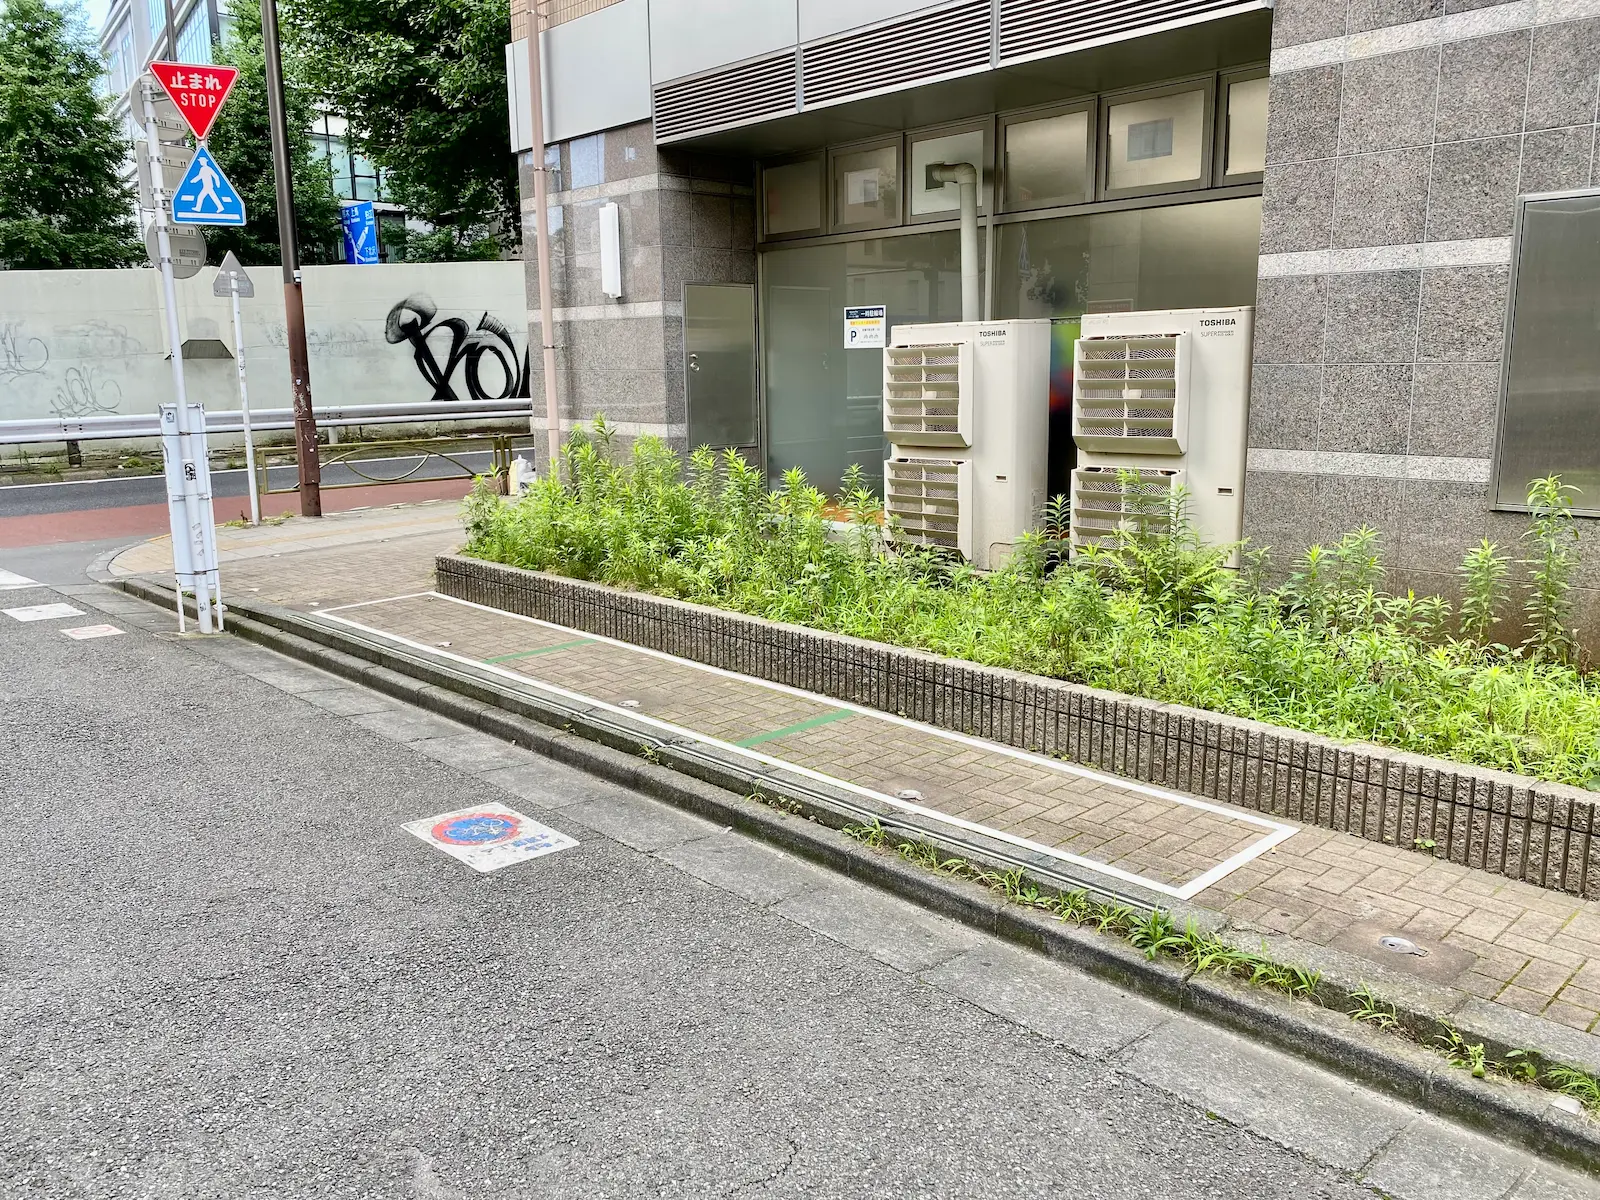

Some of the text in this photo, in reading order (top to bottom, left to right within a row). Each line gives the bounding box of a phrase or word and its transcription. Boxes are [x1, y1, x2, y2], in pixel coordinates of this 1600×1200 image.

[170, 71, 222, 90] 止まれ
[180, 93, 216, 107] STOP
[1199, 318, 1236, 327] TOSHIBA
[850, 330, 857, 342] P
